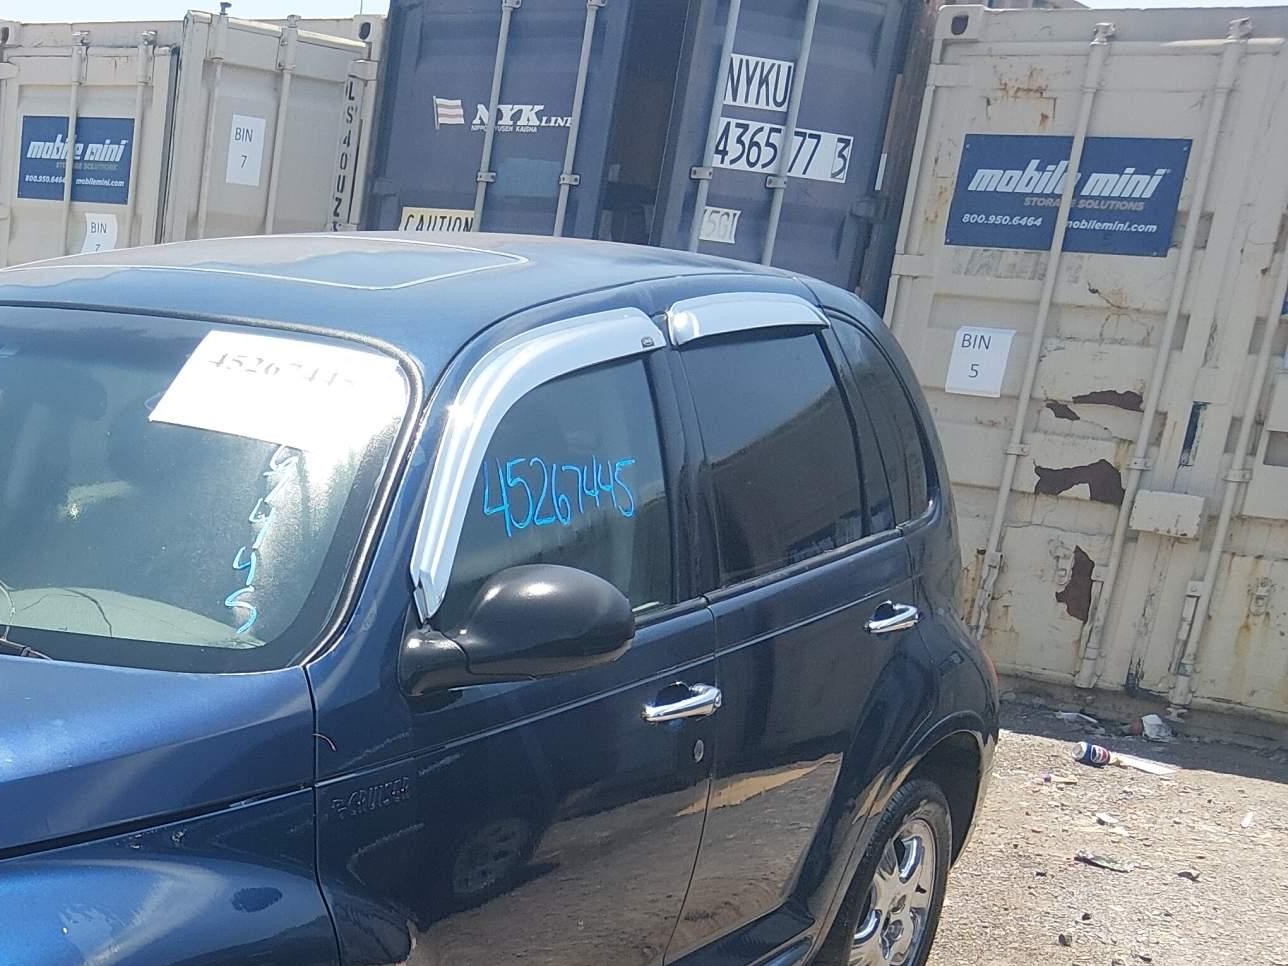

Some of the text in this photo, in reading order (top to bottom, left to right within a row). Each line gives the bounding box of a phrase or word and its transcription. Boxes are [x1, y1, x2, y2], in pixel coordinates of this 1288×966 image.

[725, 57, 792, 108] NYKU
[472, 104, 544, 125] NYK
[234, 127, 253, 142] BIN
[83, 139, 129, 162] mini
[240, 155, 248, 168] 7
[1080, 167, 1165, 199] mini
[1077, 199, 1145, 211] SOLUTIONS
[90, 222, 107, 234] BIN
[961, 213, 1043, 227] 800.950.6464
[961, 333, 992, 351] BIN
[968, 363, 980, 379] 5
[483, 454, 636, 537] 45267445
